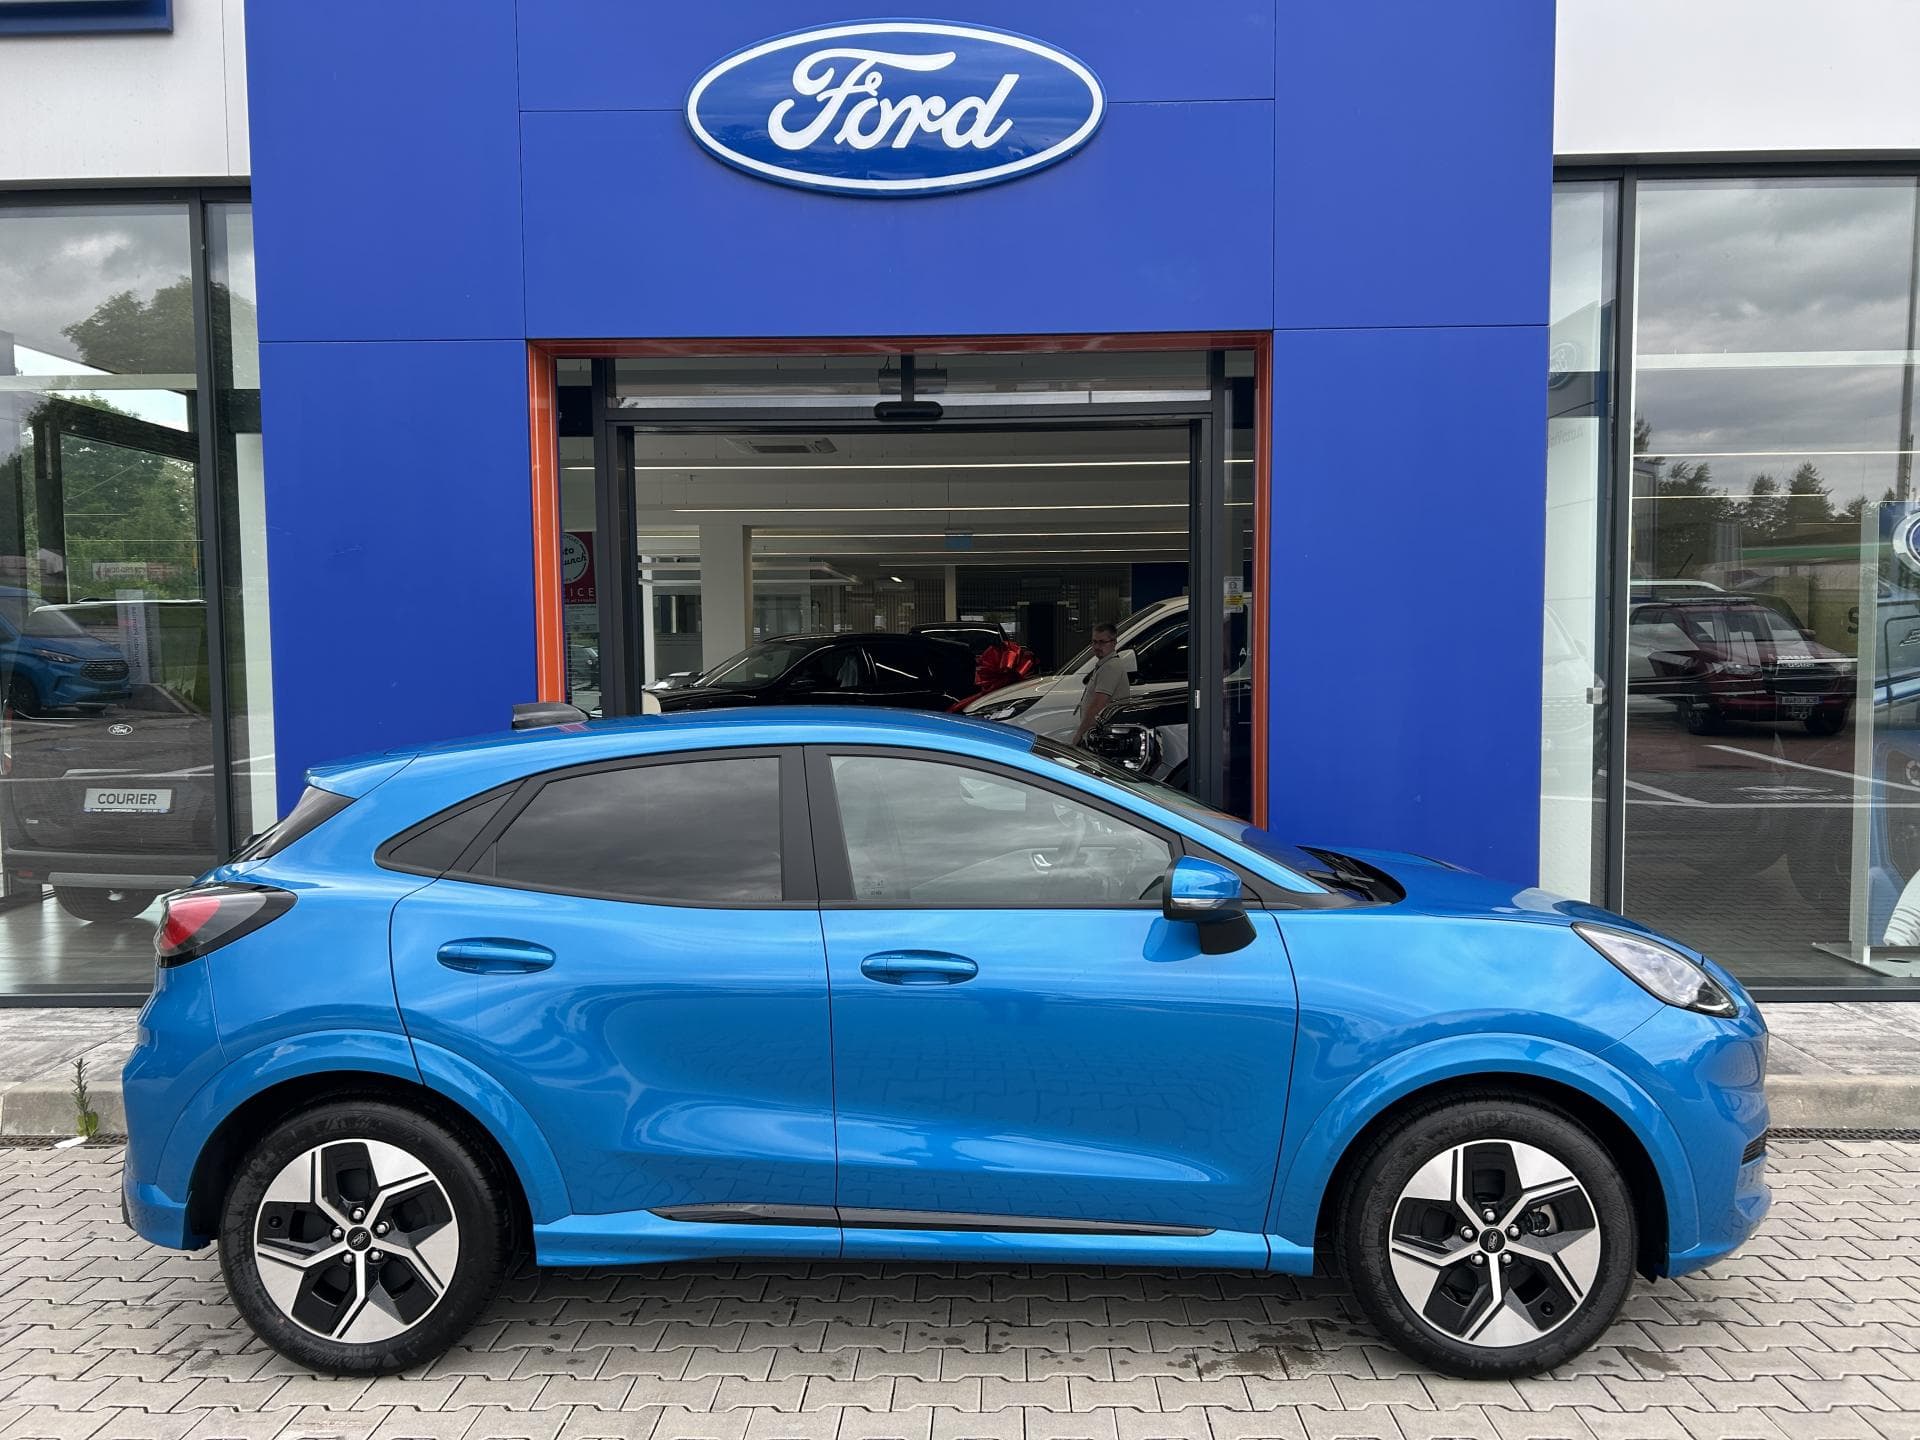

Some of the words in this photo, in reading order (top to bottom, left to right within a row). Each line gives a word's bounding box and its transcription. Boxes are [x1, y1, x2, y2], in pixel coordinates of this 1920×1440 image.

[767, 47, 1020, 151] Ford
[569, 587, 595, 597] ICE
[97, 793, 157, 805] COURIER
